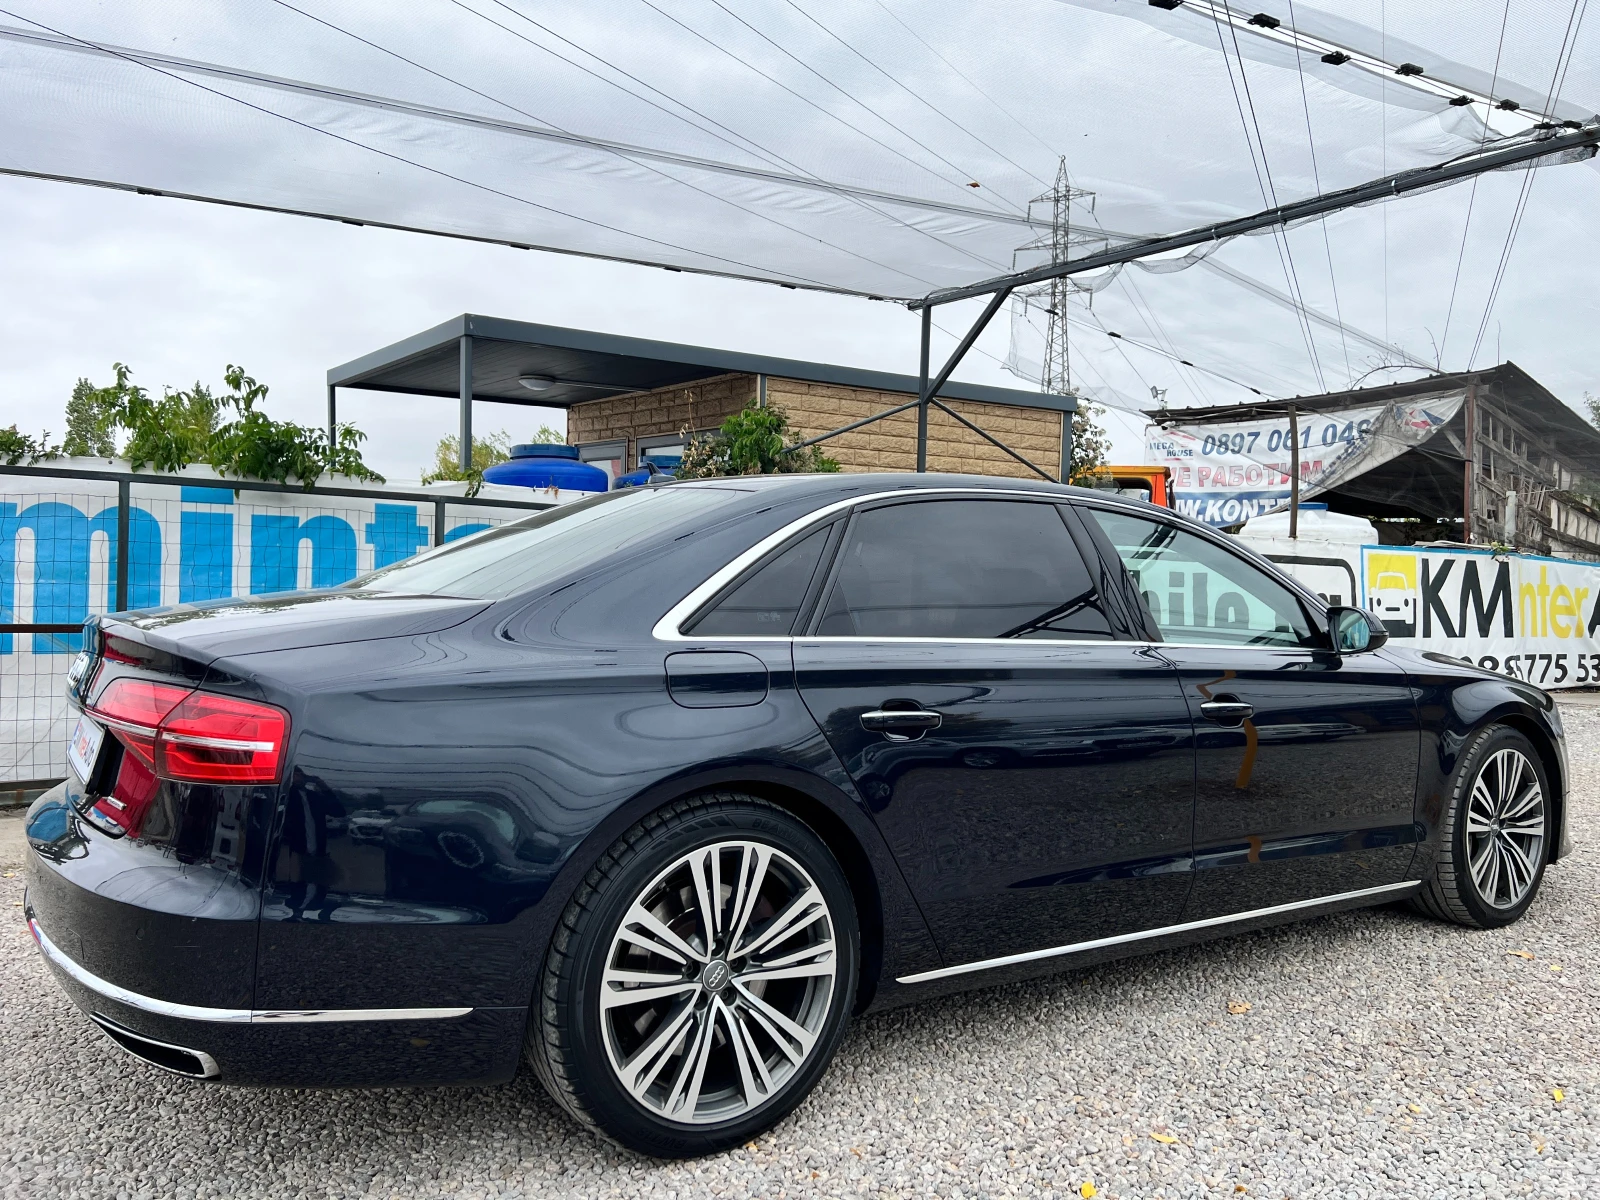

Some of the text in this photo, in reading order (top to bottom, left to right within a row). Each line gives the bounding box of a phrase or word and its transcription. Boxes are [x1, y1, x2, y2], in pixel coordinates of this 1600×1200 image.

[1166, 449, 1194, 457] HOUSE
[1202, 431, 1261, 456] 0897
[1267, 426, 1312, 452] 061
[0, 486, 492, 654] mint
